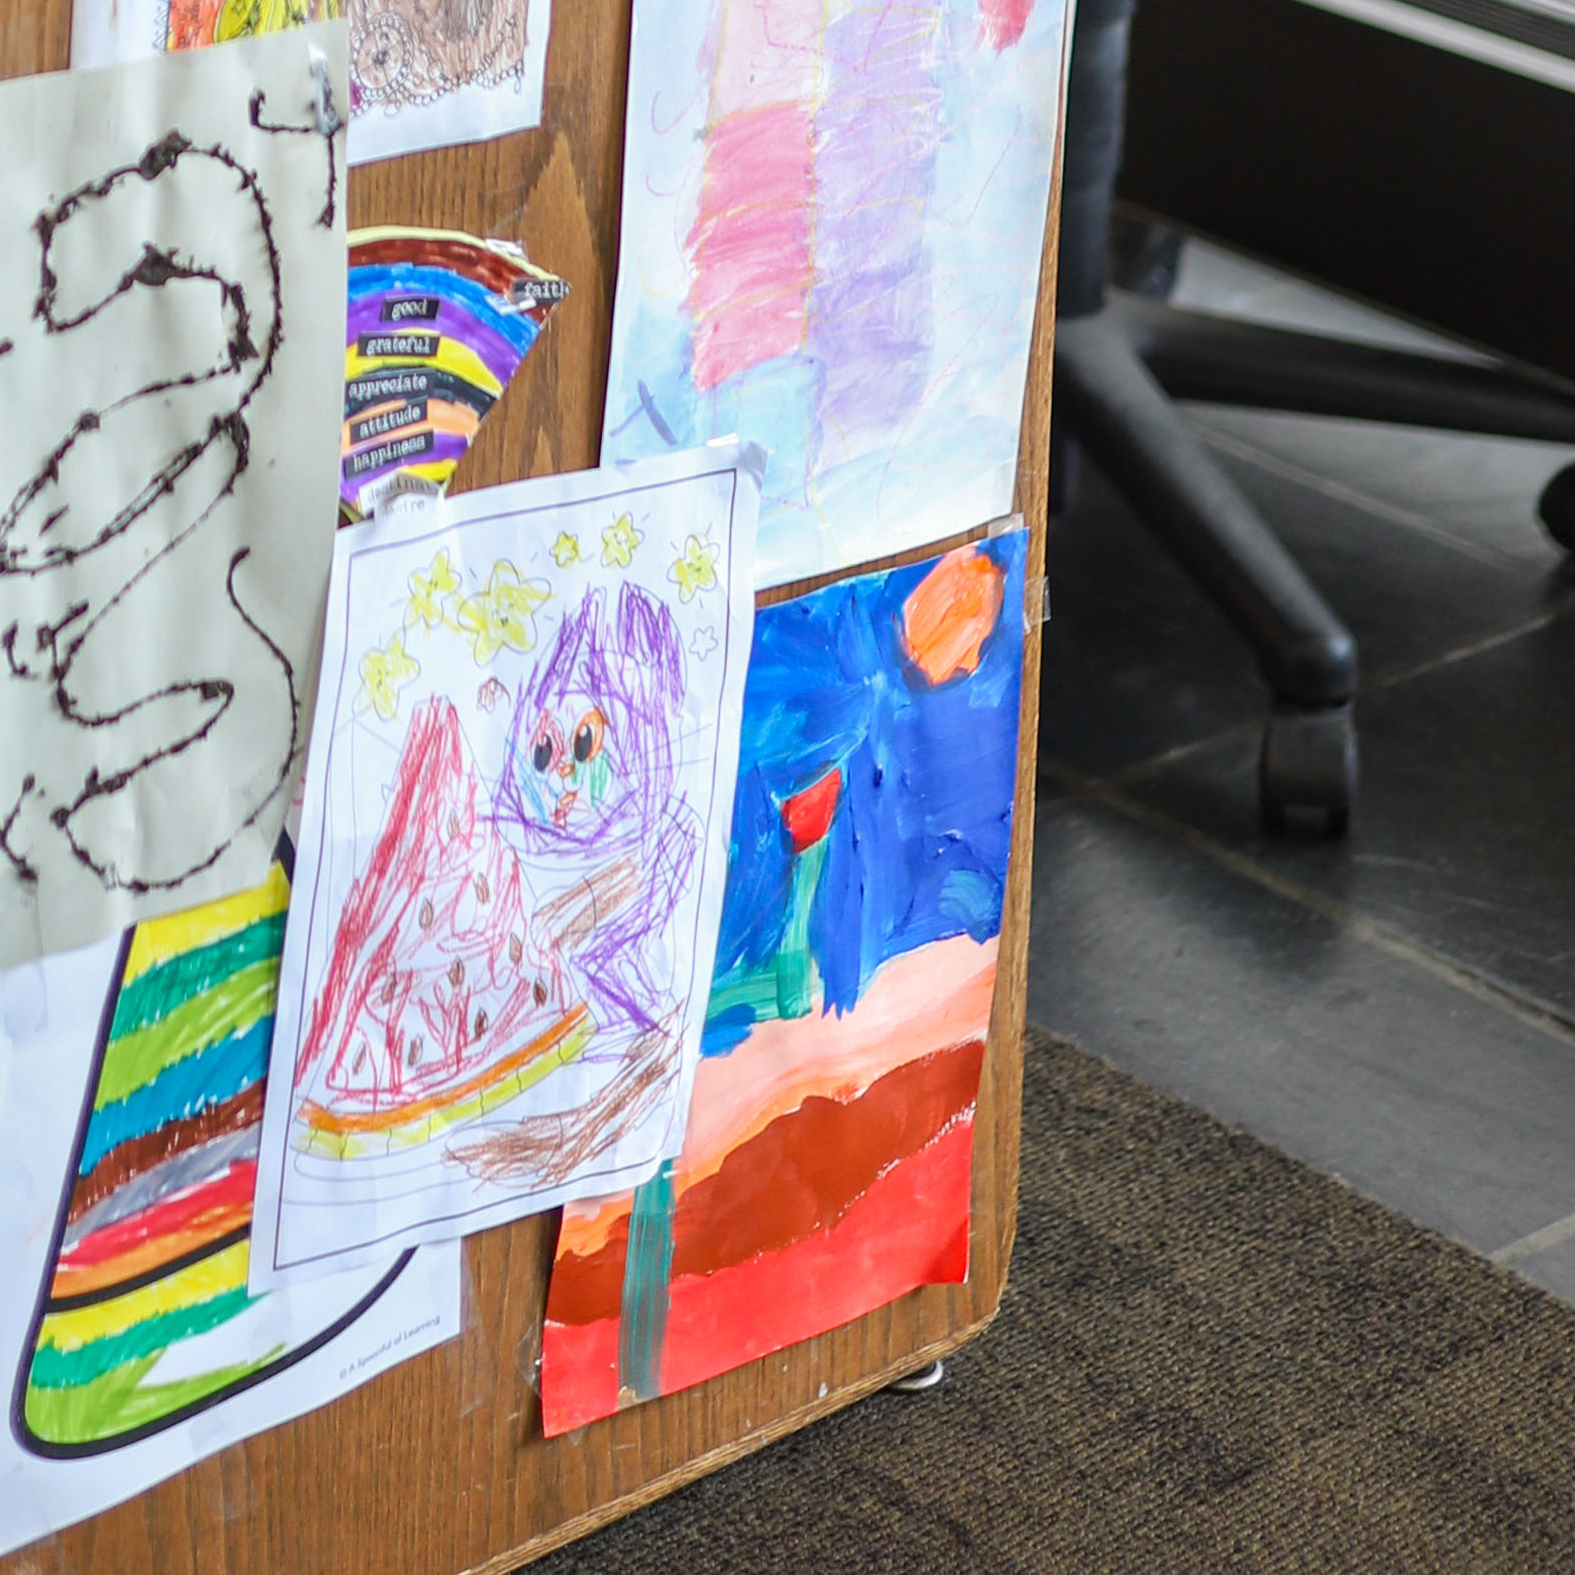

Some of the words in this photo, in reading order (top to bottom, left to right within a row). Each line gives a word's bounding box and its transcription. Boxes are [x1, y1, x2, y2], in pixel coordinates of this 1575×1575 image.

[391, 300, 429, 321] good
[366, 336, 431, 357] grateful
[348, 373, 427, 400] appreciate
[359, 404, 421, 439] attitude
[353, 435, 426, 472] happiness
[404, 1315, 440, 1340] Learning
